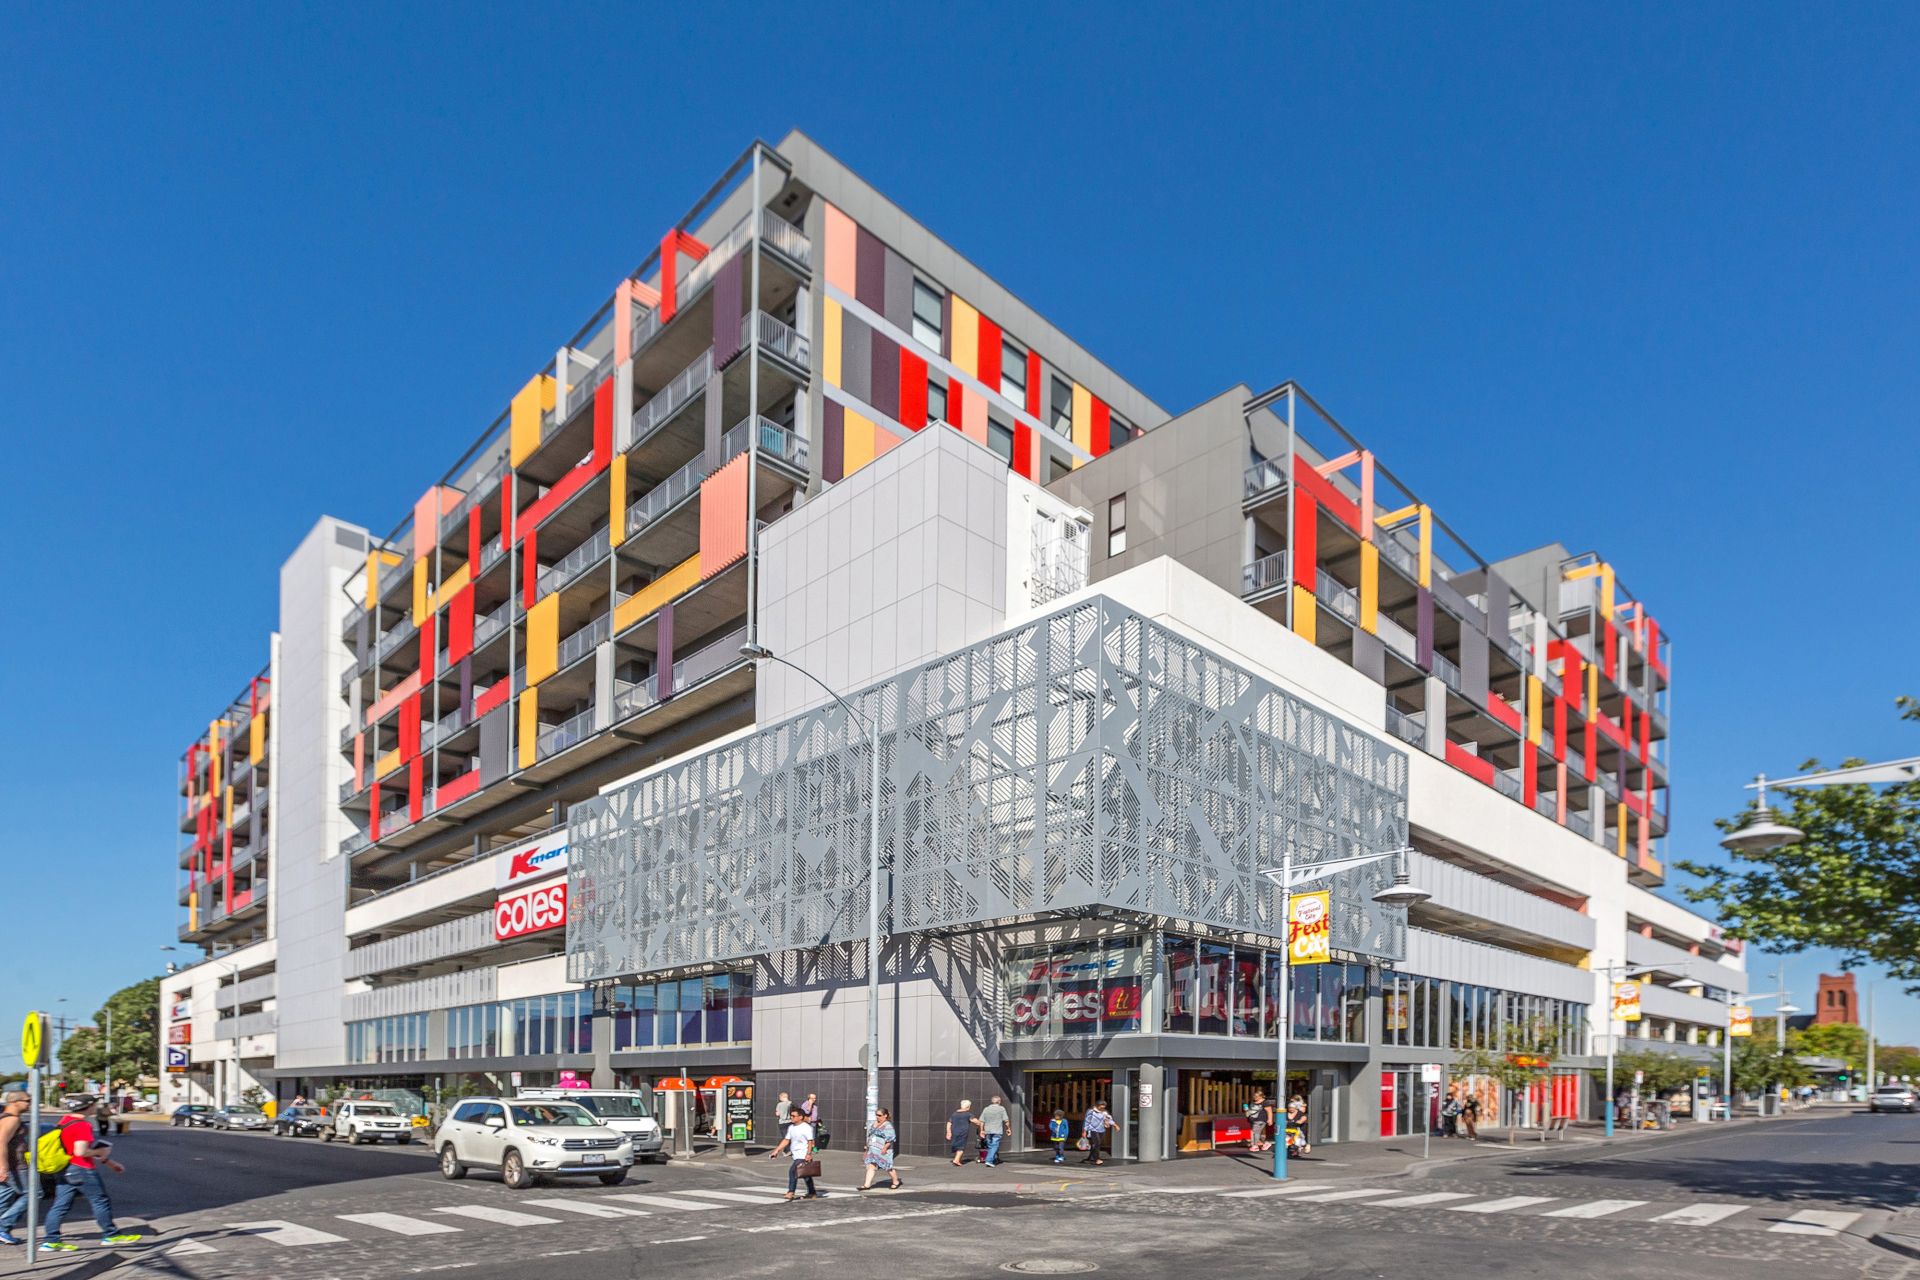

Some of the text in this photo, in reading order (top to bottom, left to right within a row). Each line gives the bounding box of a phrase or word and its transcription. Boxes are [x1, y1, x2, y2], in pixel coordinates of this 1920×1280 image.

[496, 887, 564, 936] coles
[1010, 991, 1104, 1023] coles
[169, 1052, 183, 1065] P
